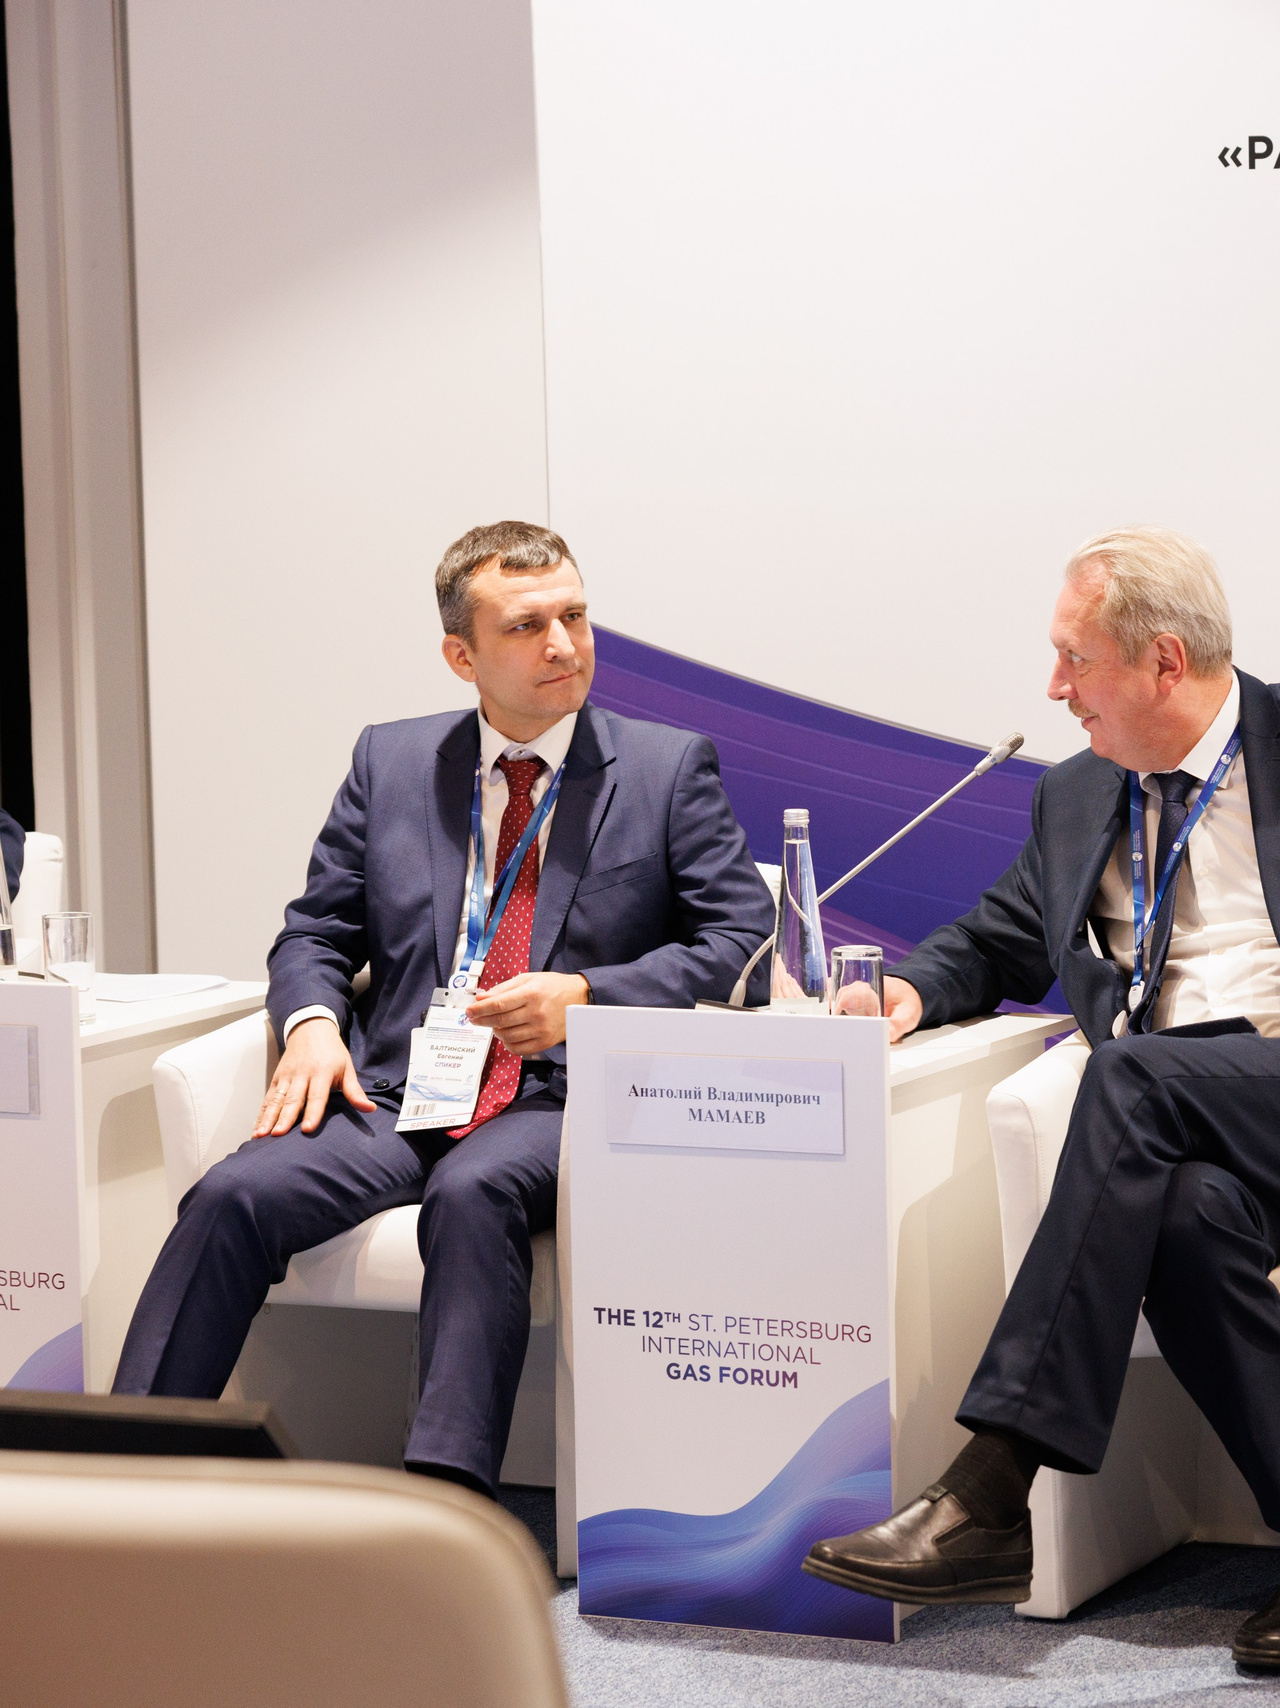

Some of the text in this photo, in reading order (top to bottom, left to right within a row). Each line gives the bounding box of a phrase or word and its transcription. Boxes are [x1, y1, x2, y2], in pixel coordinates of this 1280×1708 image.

[627, 1083, 821, 1108] Анатолий Владимирович
[410, 1118, 457, 1129] SPEAKER
[688, 1107, 766, 1125] МАМАЕВ
[593, 1306, 872, 1344] THE 12TH ST. PETERSBURG
[642, 1335, 822, 1366] INTERNATIONAL
[666, 1361, 798, 1389] GAS FORUM
